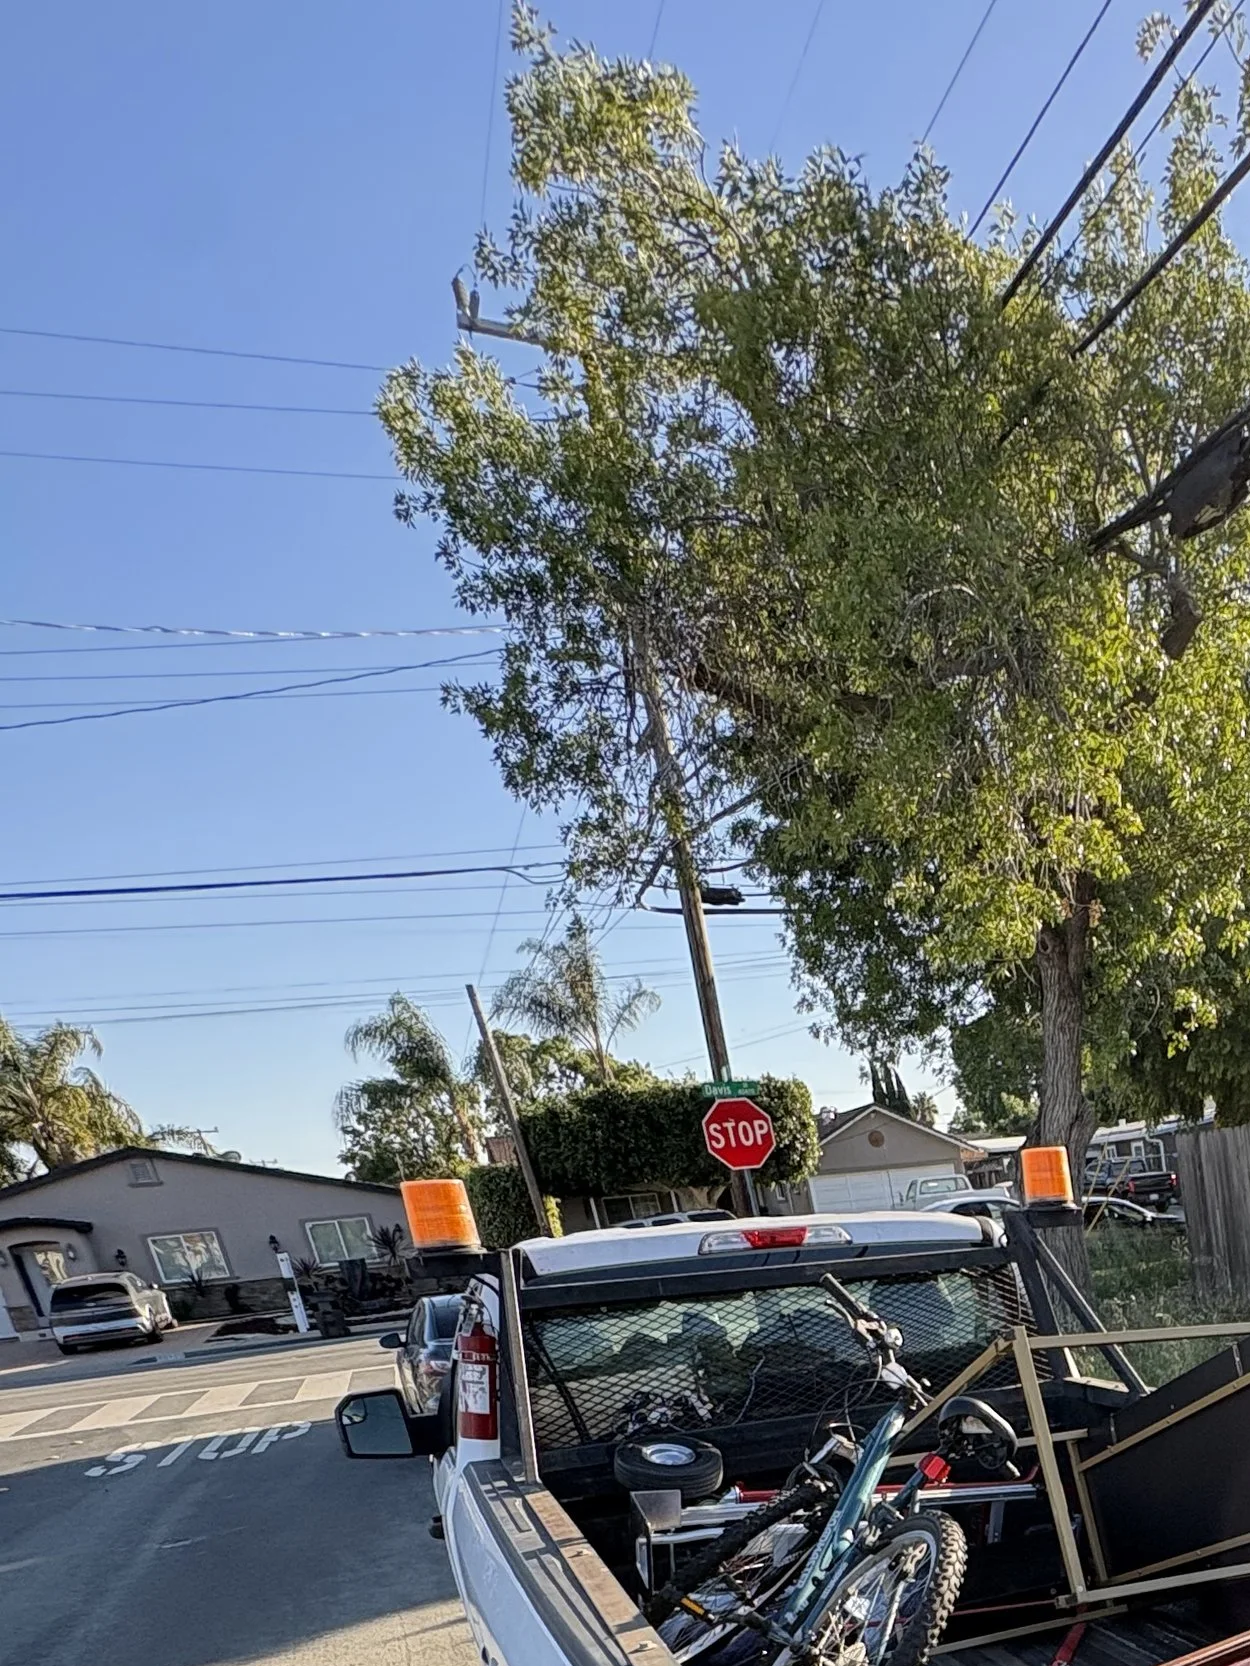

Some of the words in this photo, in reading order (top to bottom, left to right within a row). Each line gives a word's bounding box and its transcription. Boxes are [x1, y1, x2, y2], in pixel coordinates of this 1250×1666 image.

[704, 1084, 732, 1096] Davis
[708, 1119, 769, 1149] STOP
[84, 1421, 312, 1477] STOP
